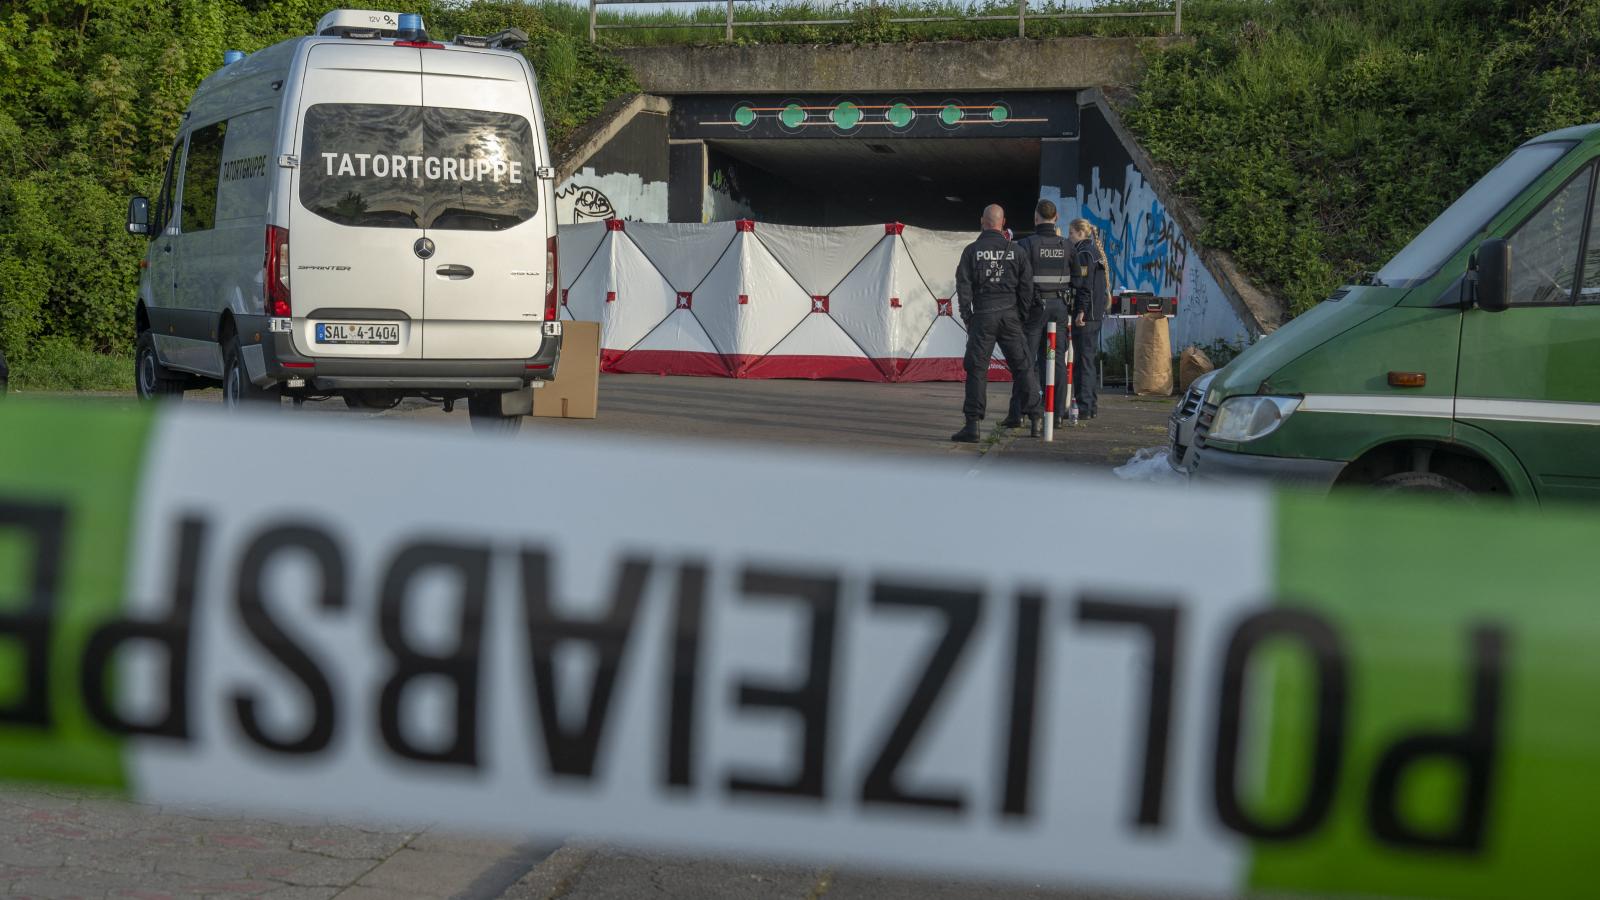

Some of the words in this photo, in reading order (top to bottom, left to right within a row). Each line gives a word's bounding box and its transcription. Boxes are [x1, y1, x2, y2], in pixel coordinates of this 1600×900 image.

[223, 154, 266, 182] TATORTGRUPPE
[321, 152, 522, 184] TATORTGRUPPE
[976, 250, 1015, 261] POLIZEI
[1040, 248, 1065, 258] POLIZEI
[325, 325, 348, 339] SAL
[357, 326, 397, 340] 4-1404
